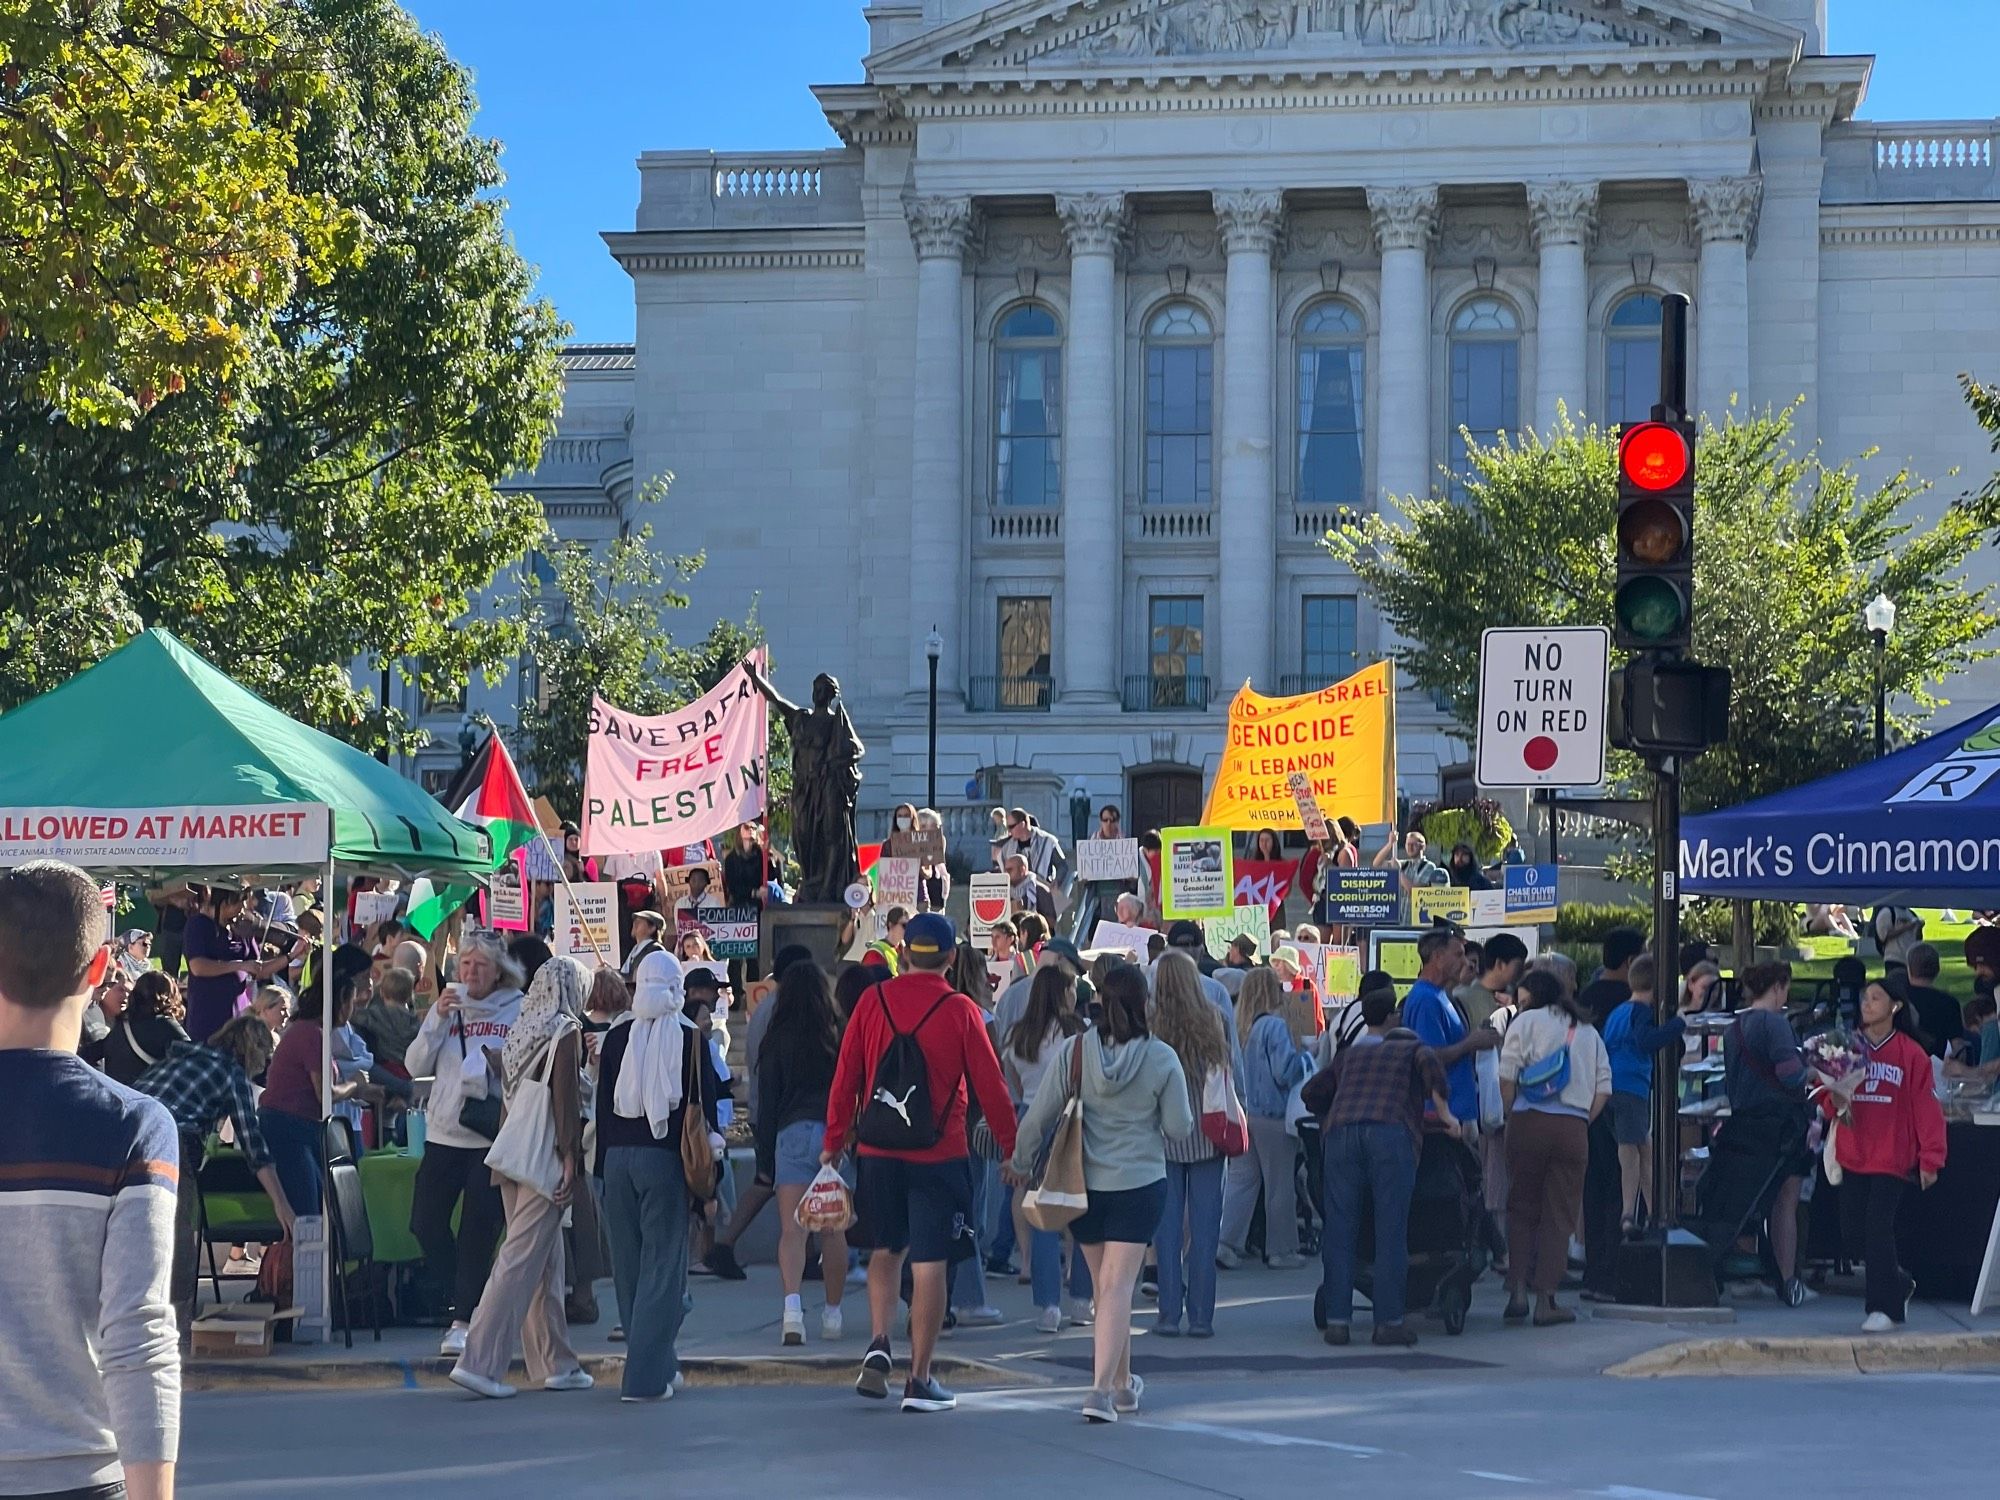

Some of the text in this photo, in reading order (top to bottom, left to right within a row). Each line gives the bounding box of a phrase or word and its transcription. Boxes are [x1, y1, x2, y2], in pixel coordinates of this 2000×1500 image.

[1525, 643, 1562, 671] NO
[1317, 679, 1388, 705] ISRAEL
[1514, 679, 1572, 701] TURN
[589, 707, 669, 747] SAVE
[1232, 715, 1355, 747] GENOCIDE
[1497, 710, 1587, 732] ON RED
[636, 734, 723, 782] FREE
[1233, 751, 1335, 775] IN LEBANON
[1239, 778, 1338, 801] PALESNE
[135, 815, 174, 839] AT
[180, 812, 306, 839] MARKET
[20, 847, 55, 857] ANIMALS
[55, 847, 72, 857] PER
[84, 847, 107, 856] STATE
[108, 847, 136, 856] ADMIN
[136, 847, 161, 856] CODE
[1680, 836, 1793, 879] Mark's
[889, 860, 910, 875] NO
[1080, 856, 1138, 873] INTIFADA
[879, 874, 916, 890] MORE
[1341, 880, 1386, 888] DISRUPT
[1507, 887, 1531, 897] CHASE
[1329, 893, 1397, 902] CORRUPTION
[697, 907, 758, 922] BOMBING
[717, 926, 730, 939] IS
[733, 925, 758, 938] NOT
